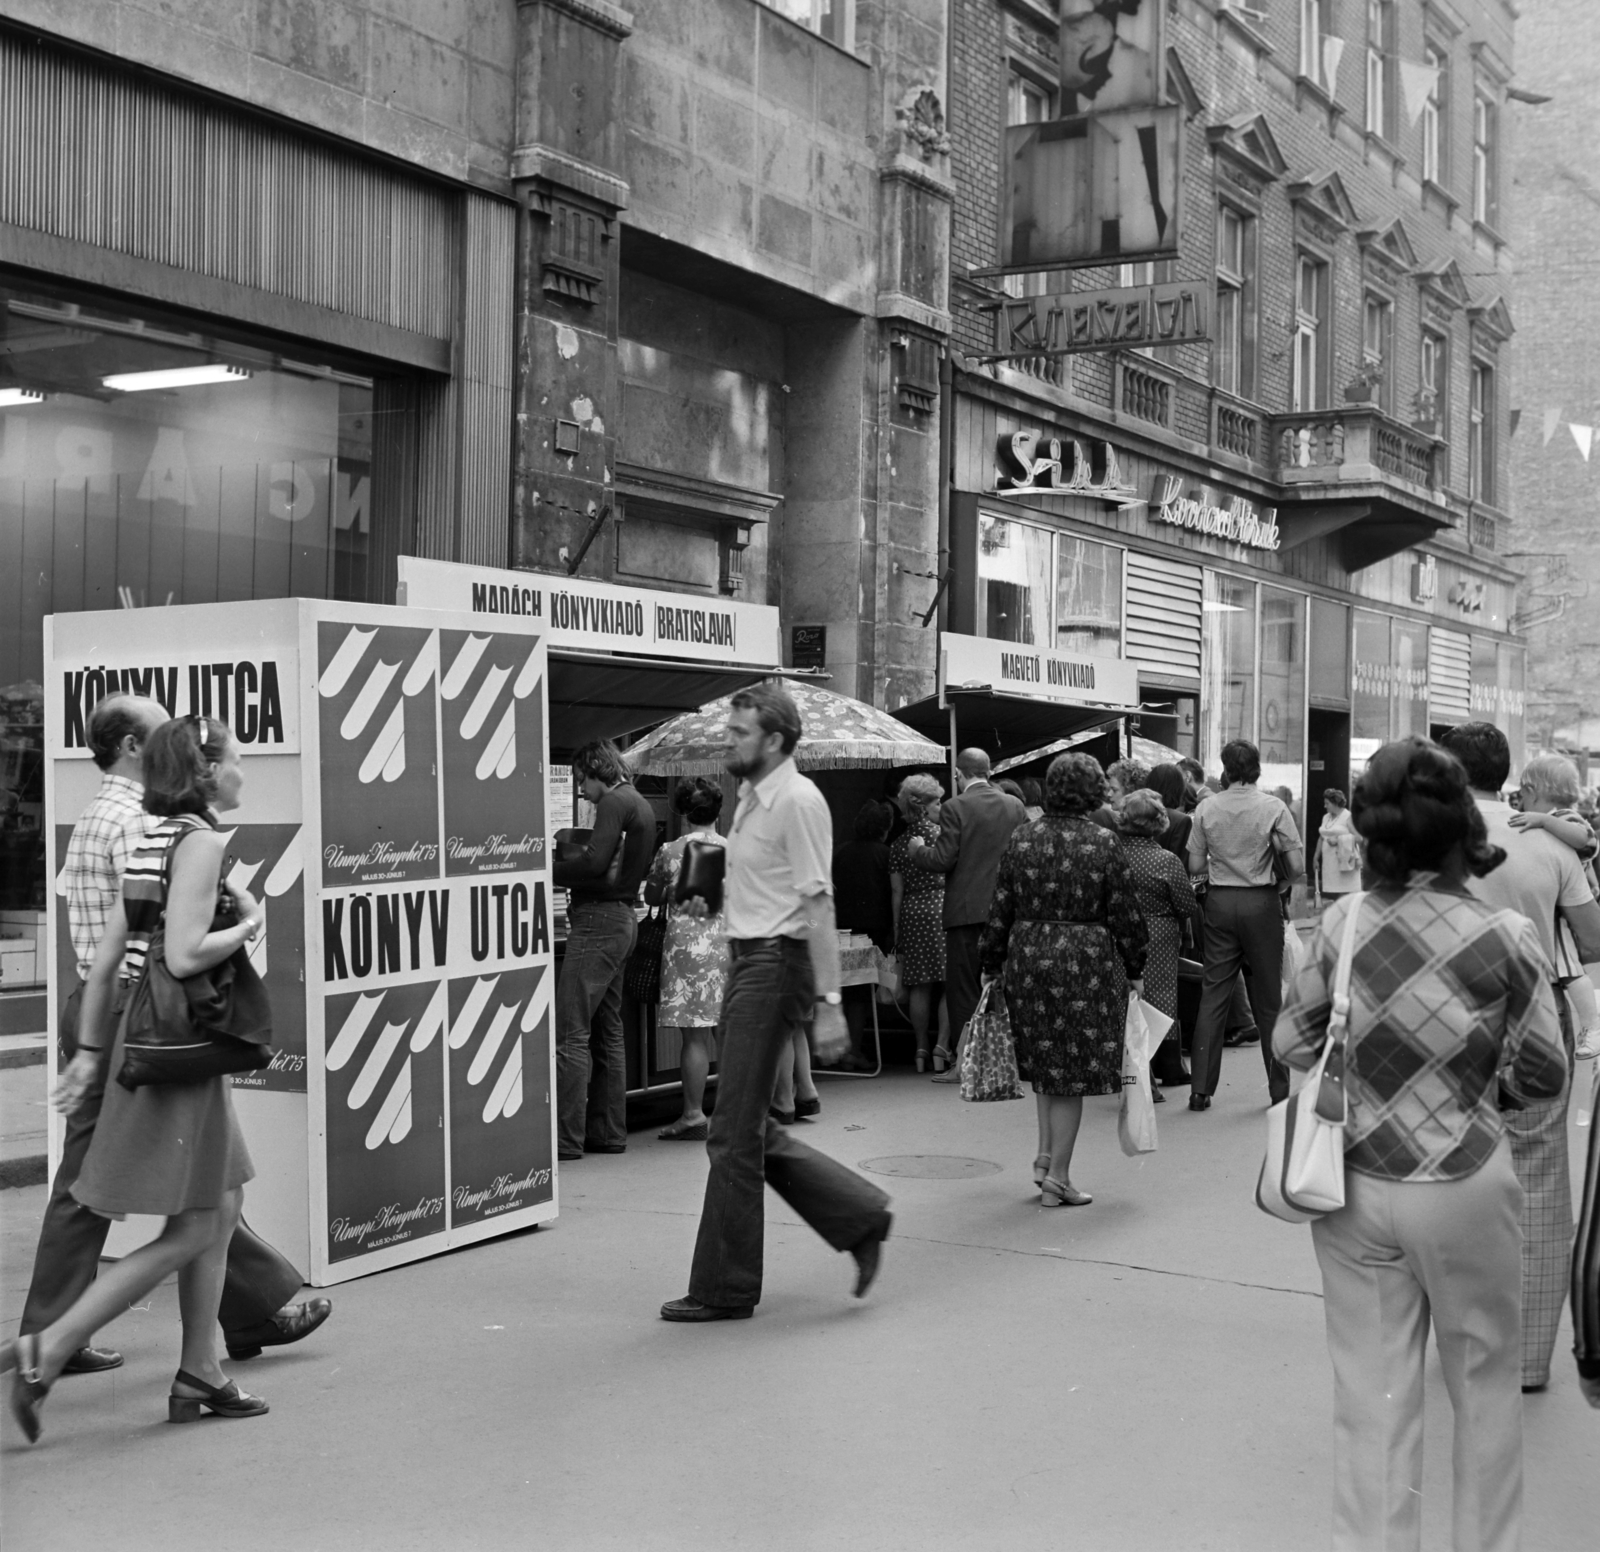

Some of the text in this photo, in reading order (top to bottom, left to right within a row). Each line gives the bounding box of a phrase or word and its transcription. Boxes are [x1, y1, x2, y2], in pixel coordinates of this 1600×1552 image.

[550, 590, 644, 637] KÖNYVKIADÓ
[1001, 652, 1095, 690] MAGVETŐ KÖNYVKIADÓ
[324, 843, 370, 874] Ünnepi
[446, 836, 485, 864] Ünnepi
[322, 881, 550, 982] KÖNYV UTCA
[452, 1185, 491, 1211] Ünnepi
[330, 1217, 375, 1245] Ünnepi
